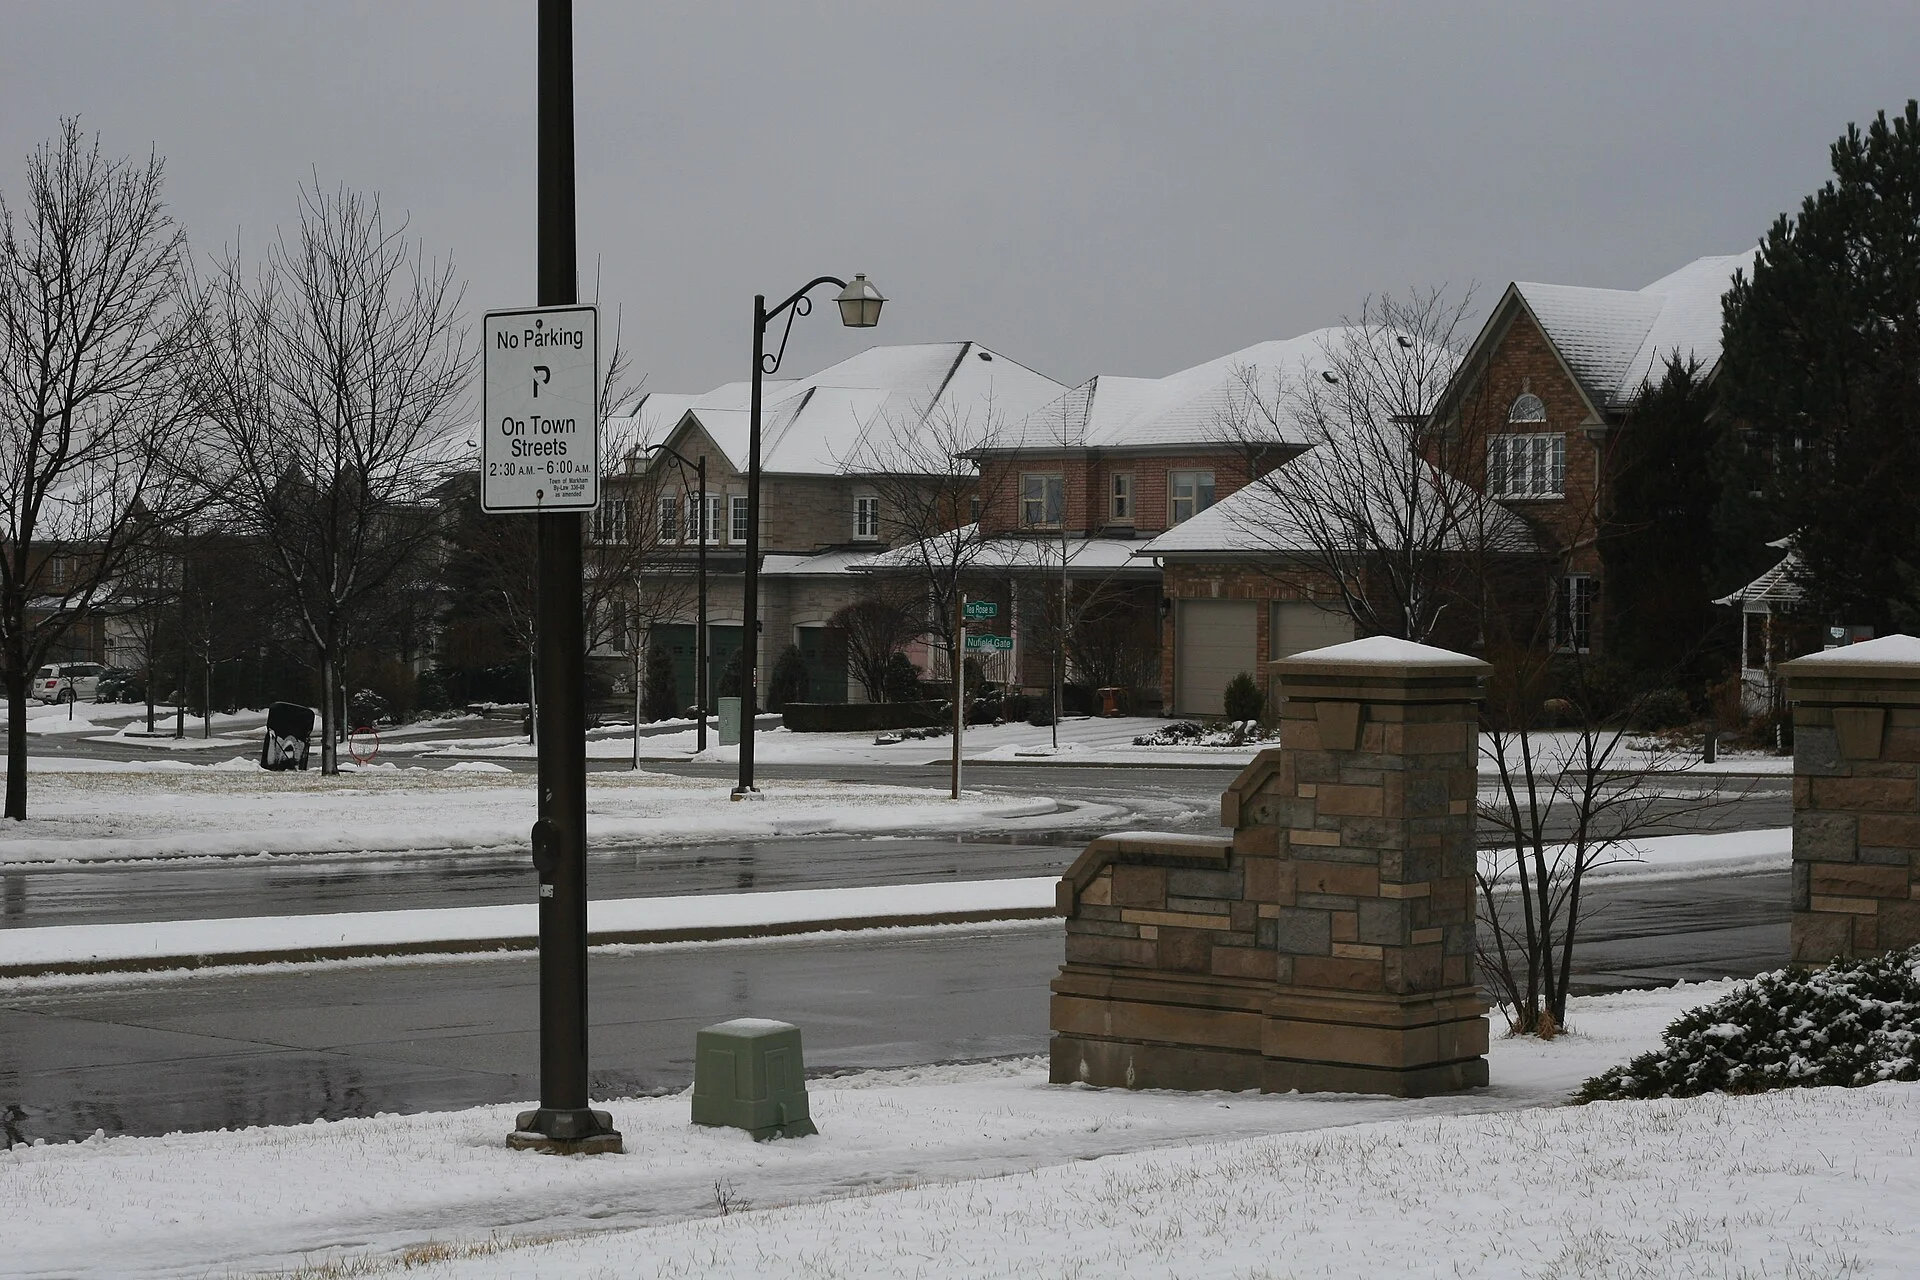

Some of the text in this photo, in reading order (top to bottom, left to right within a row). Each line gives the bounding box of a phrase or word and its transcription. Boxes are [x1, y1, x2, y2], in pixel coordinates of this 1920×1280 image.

[498, 328, 583, 349] No Parking
[501, 415, 576, 436] On Town
[511, 438, 567, 457] Streets
[490, 462, 515, 476] 2:30
[518, 465, 535, 475] A.M.
[546, 460, 573, 474] 6:00
[575, 464, 591, 473] A.M.
[966, 604, 975, 614] Tea
[975, 604, 989, 614] Rose
[994, 638, 1011, 648] Gate
